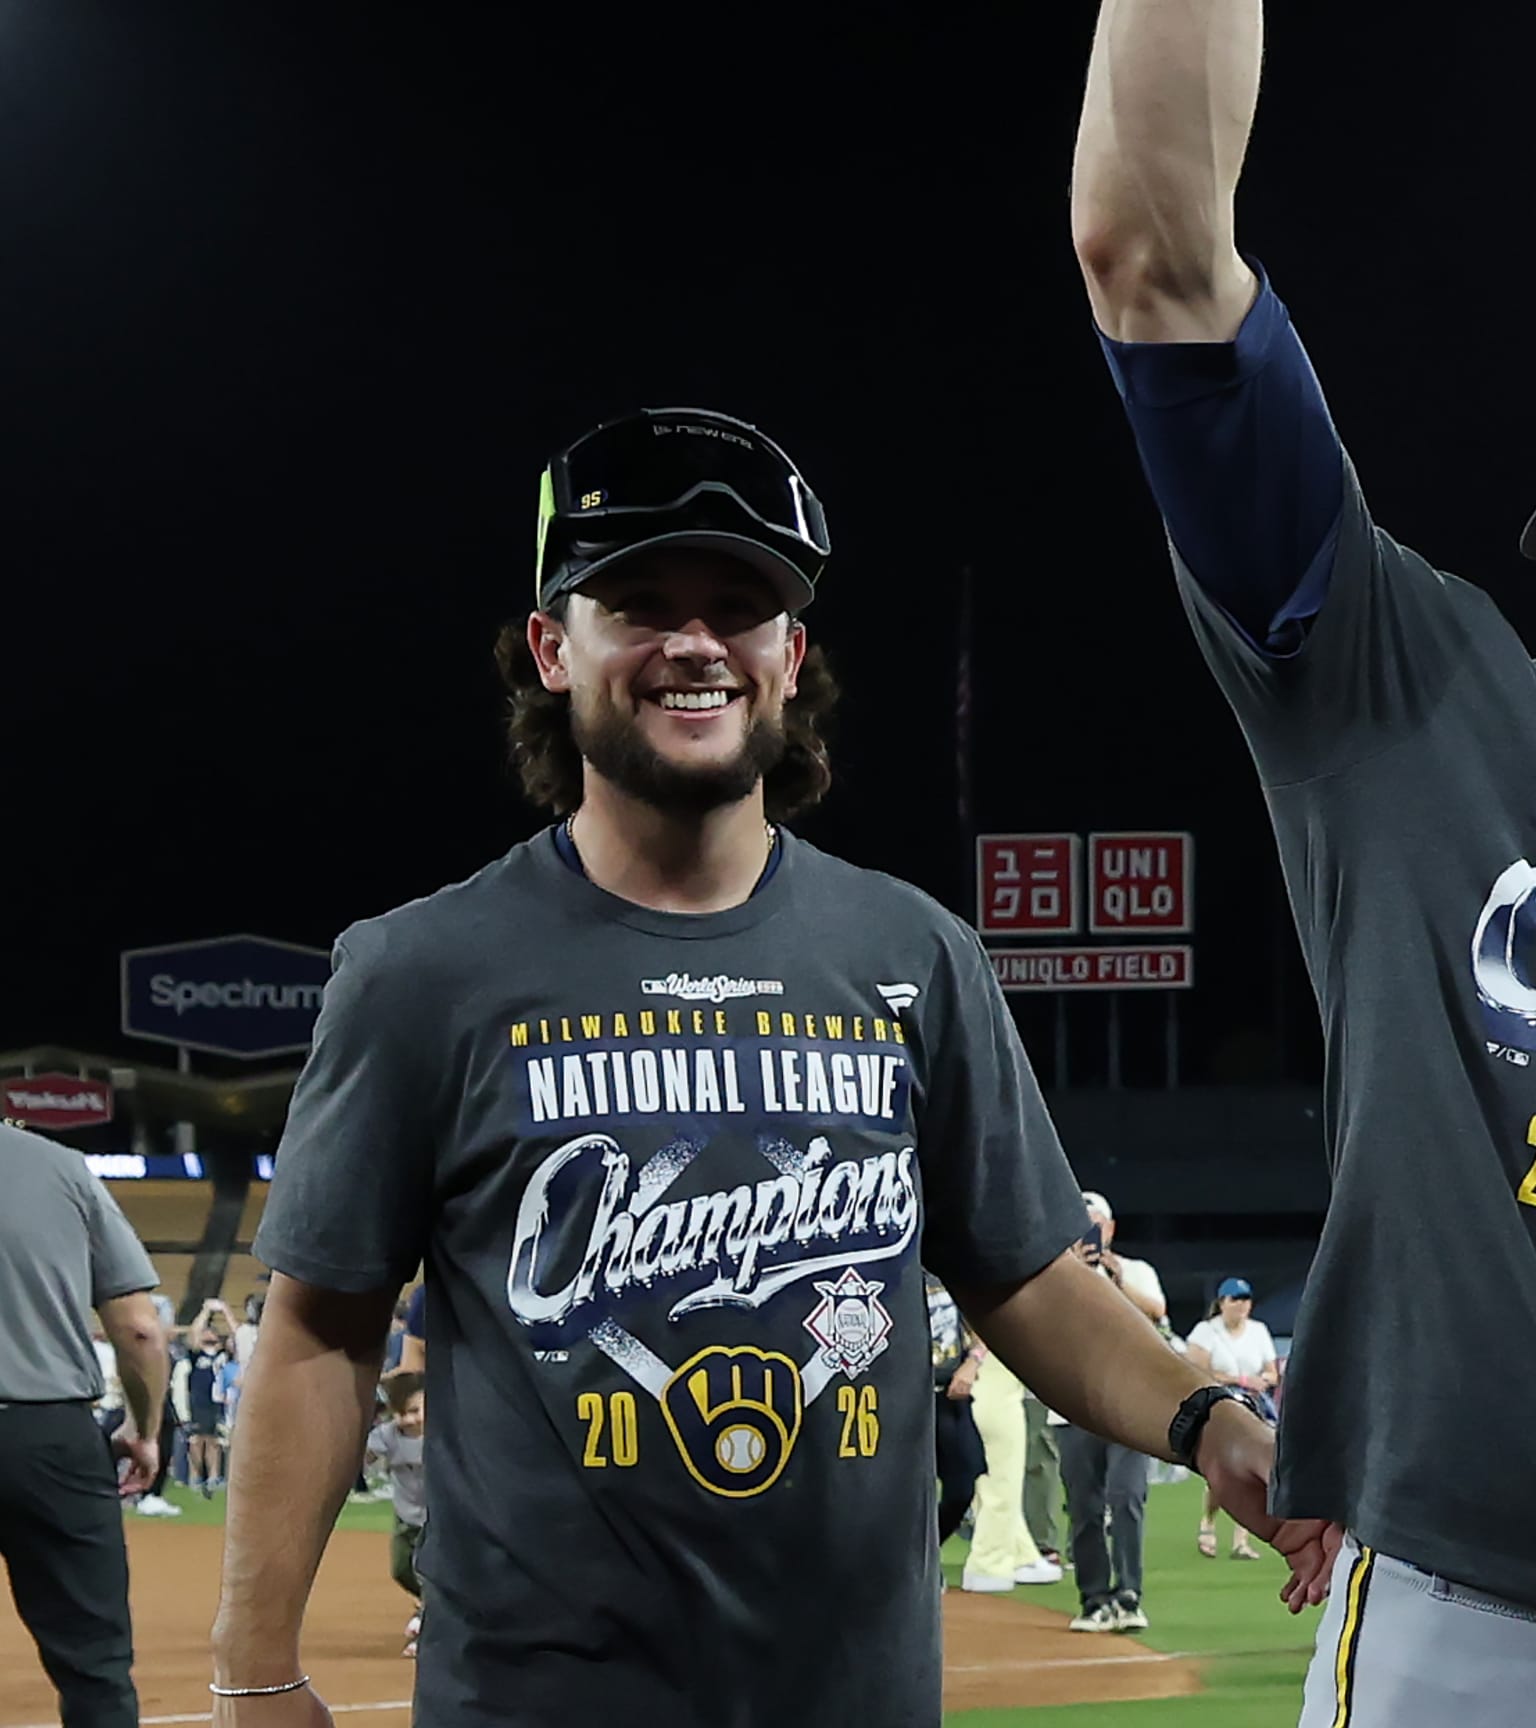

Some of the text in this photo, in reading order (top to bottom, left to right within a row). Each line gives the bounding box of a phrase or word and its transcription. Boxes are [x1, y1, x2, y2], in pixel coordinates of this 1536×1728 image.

[581, 490, 602, 510] 95
[1102, 848, 1168, 879] UNI
[1103, 885, 1174, 922] QLO
[994, 954, 1177, 985] UNIQLO FIELD
[150, 973, 325, 1017] Spectrum
[510, 1010, 905, 1047] MILWAUKEE BREWERS
[527, 1049, 899, 1123] NATIONAL LEAGUE
[507, 1133, 918, 1326] Champions
[577, 1384, 880, 1468] 20 26
